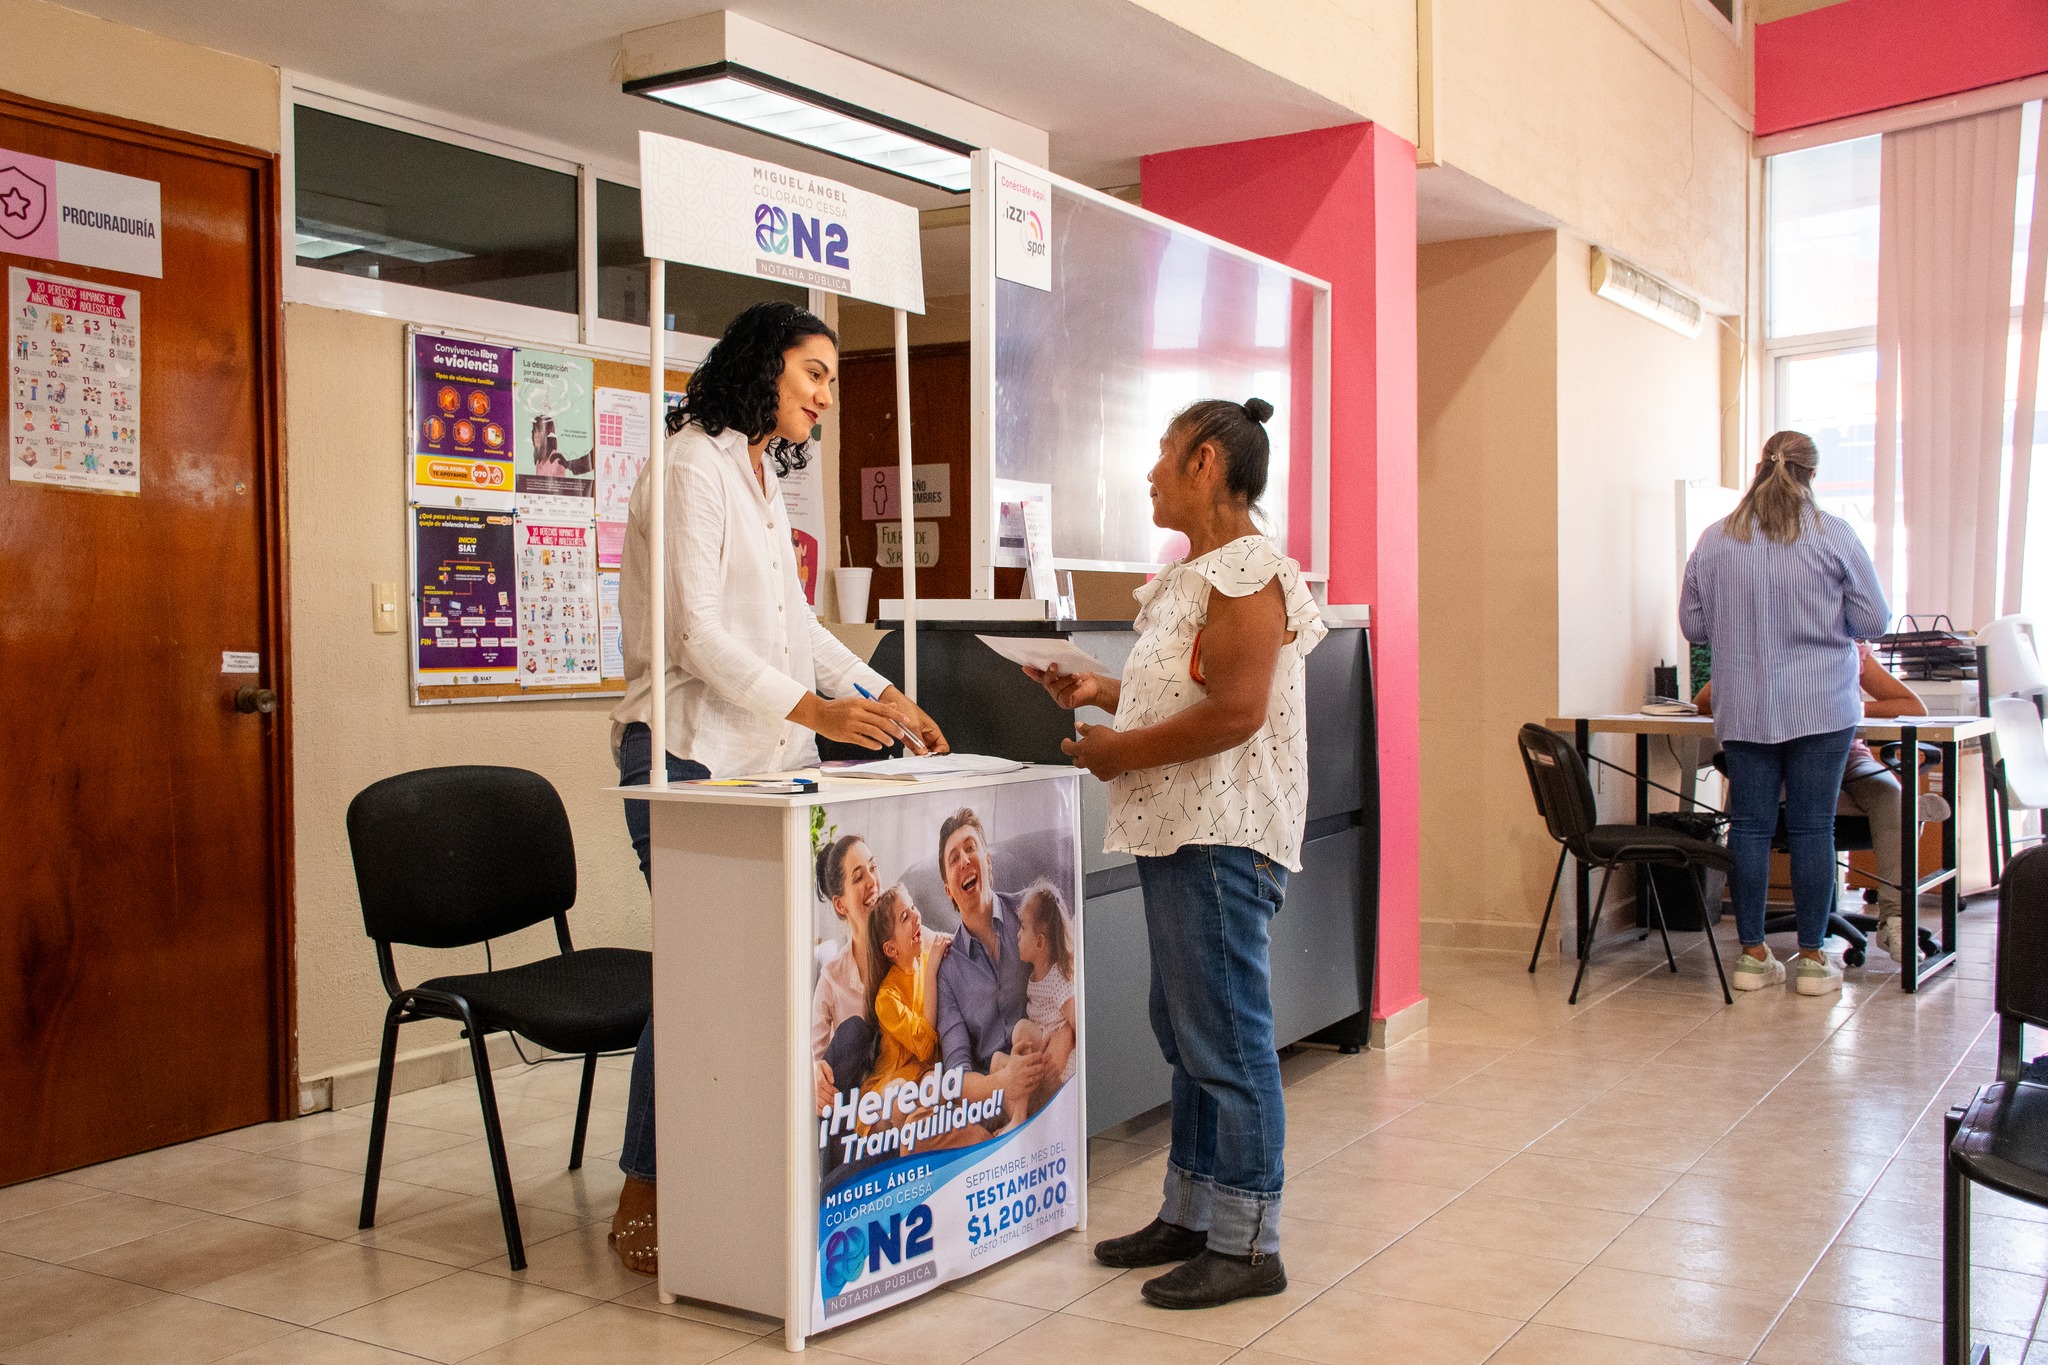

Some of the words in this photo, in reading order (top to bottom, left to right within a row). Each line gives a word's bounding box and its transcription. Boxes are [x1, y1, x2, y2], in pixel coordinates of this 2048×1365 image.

[753, 167, 803, 190] MIGUEL
[808, 180, 848, 203] ÁNGEL
[1001, 176, 1031, 196] Conéctate
[753, 184, 813, 209] COLORADO
[816, 201, 848, 219] CESSA
[62, 205, 156, 239] PROCURADURÍA
[792, 212, 850, 270] N2
[1027, 240, 1046, 257] spot
[761, 263, 805, 280] NOTARÍA
[808, 273, 848, 290] PÚBLICA
[36, 282, 46, 293] 20
[47, 284, 77, 299] DERECHOS
[80, 291, 106, 304] HUMANOS
[108, 295, 115, 306] DE
[23, 307, 27, 317] 1
[52, 295, 70, 309] NIÑOS
[71, 299, 77, 309] Y
[80, 301, 121, 317] ADOLESCENTES
[66, 315, 73, 325] 2
[93, 321, 100, 331] 3
[110, 319, 117, 329] 4
[32, 341, 38, 350] 5
[51, 339, 57, 347] 6
[80, 344, 86, 352] 7
[109, 348, 115, 358] 8
[435, 344, 480, 357] Convivencia
[480, 349, 498, 360] libre
[14, 366, 20, 374] 9
[433, 355, 444, 364] de
[445, 355, 499, 374] violencia
[532, 361, 568, 372] desaparición
[47, 370, 57, 378] 10
[83, 376, 90, 385] 11
[435, 372, 448, 380] Tipos
[456, 375, 477, 383] violencia
[478, 377, 495, 386] familiar
[109, 381, 117, 389] 12
[15, 402, 24, 410] 13
[49, 406, 58, 414] 14
[81, 408, 88, 416] 15
[109, 413, 117, 421] 16
[15, 437, 24, 445] 17
[45, 437, 54, 445] 18
[912, 479, 926, 492] AÑO
[912, 491, 942, 504] OMBRES
[881, 526, 902, 544] FUER
[458, 544, 476, 552] SIAT
[420, 638, 432, 646] FIN
[819, 1061, 964, 1149] ¡Hereda
[841, 1088, 1004, 1164] Tranquilidad!
[966, 1156, 1029, 1189] SEPTIEMBRE,
[1030, 1148, 1048, 1164] MES
[1050, 1141, 1066, 1157] DEL
[826, 1180, 882, 1209] MIGUEL
[886, 1164, 933, 1190] ÁNGEL
[965, 1157, 1066, 1212] TESTAMENTO
[825, 1195, 892, 1227] COLORADO
[896, 1182, 933, 1204] CESSA
[967, 1180, 1067, 1245] $1,200.00
[868, 1203, 934, 1273] N2
[970, 1239, 998, 1260] (COSTO
[1000, 1230, 1020, 1245] TOTAL
[1021, 1222, 1034, 1235] DEL
[1036, 1207, 1067, 1227] TRÁMITE)
[831, 1285, 881, 1311] NOTARÍA
[885, 1266, 931, 1292] PÚBLICA
